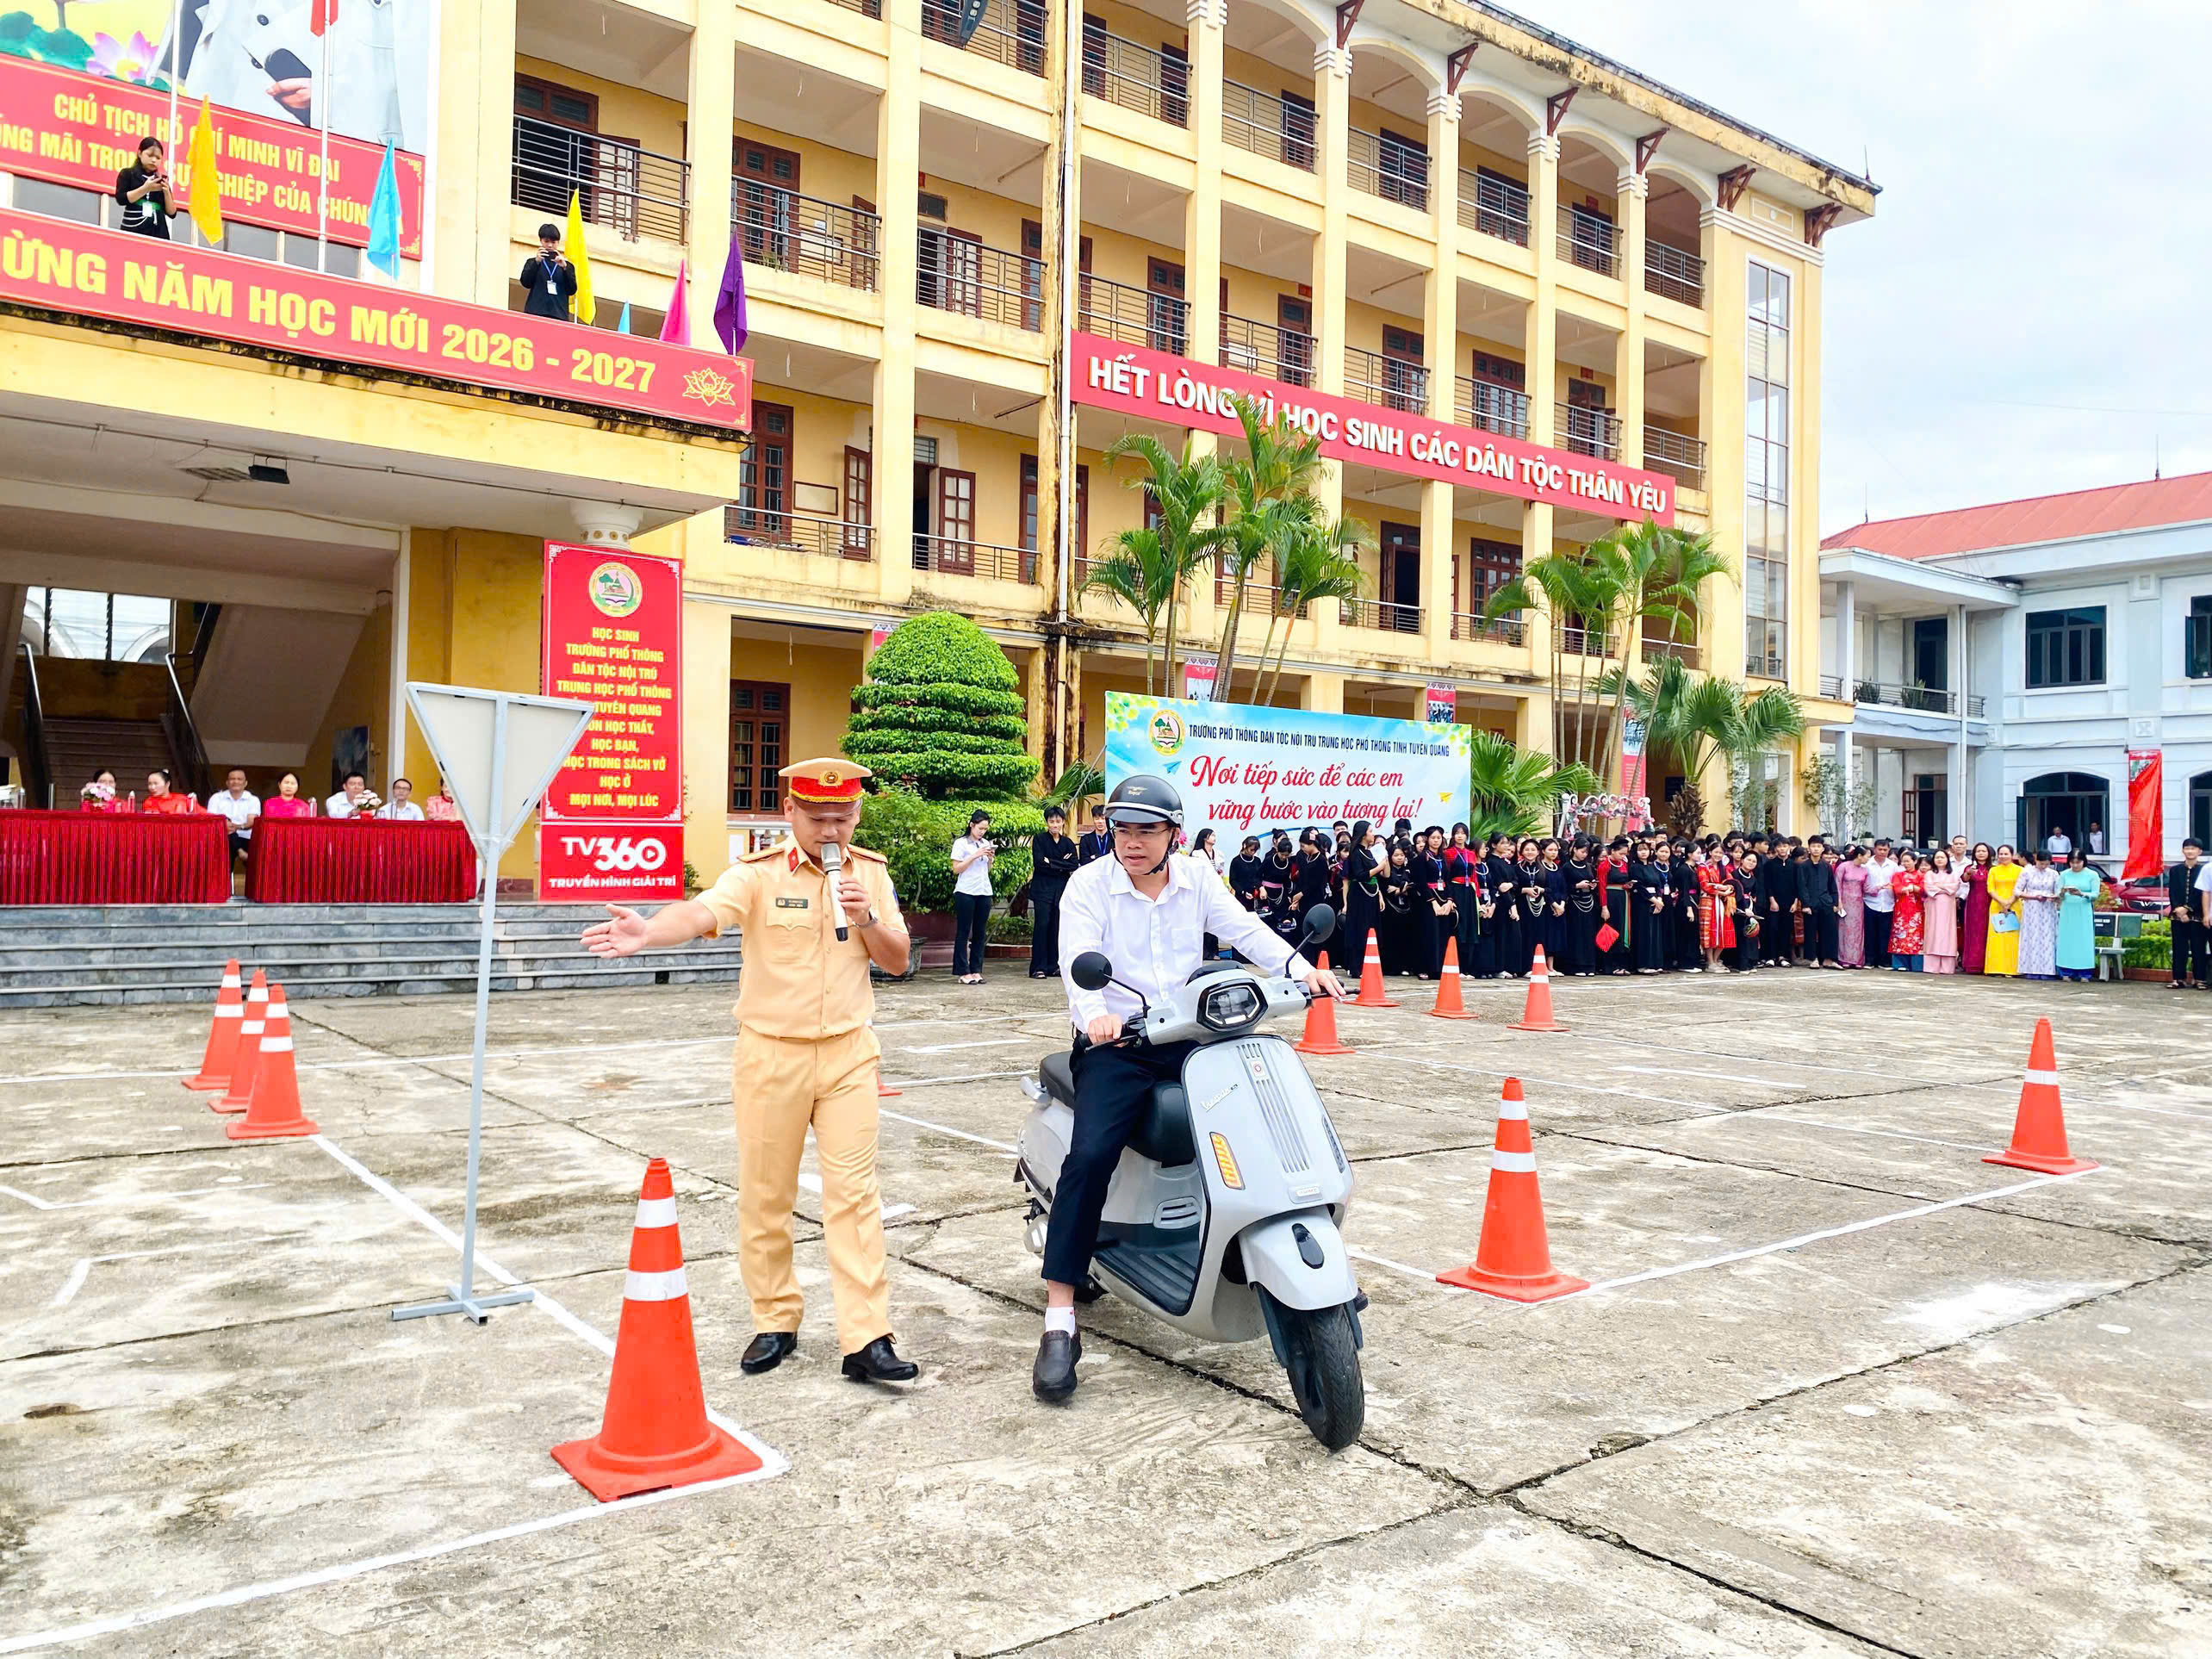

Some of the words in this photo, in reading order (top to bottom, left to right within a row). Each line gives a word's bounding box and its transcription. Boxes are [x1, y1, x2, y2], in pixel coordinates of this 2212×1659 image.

[54, 93, 97, 126] CHỦ
[103, 104, 150, 138] TỊCH
[228, 134, 280, 169] MINH
[286, 146, 303, 174] VĨ
[40, 132, 83, 164] MÃI
[273, 180, 312, 214] CỦA
[123, 260, 233, 318] NĂM
[249, 285, 336, 339] HỌC
[351, 306, 429, 353] MỚI
[442, 324, 534, 371] 2026
[571, 348, 656, 393] 2027
[1089, 353, 1151, 398] HẾT
[1158, 368, 1238, 419] LÒNG
[1345, 418, 1403, 457] SINH
[1408, 431, 1460, 468] CÁC
[1465, 444, 1514, 480] DÂN
[1519, 454, 1563, 494] TỘC
[1567, 469, 1624, 504] THÂN
[1627, 480, 1667, 513] YÊU
[593, 627, 612, 641] HỌC
[615, 629, 639, 642] SINH
[557, 680, 591, 693] TRUNG
[593, 682, 614, 697] HỌC
[629, 704, 662, 717] QUANG
[605, 720, 625, 735] HỌC
[592, 738, 612, 753] HỌC
[1318, 735, 1339, 749] TRUNG
[1430, 744, 1450, 756] QUANG
[587, 757, 621, 769] TRONG
[624, 756, 650, 770] SÁCH
[600, 775, 621, 790] HỌC
[1190, 755, 1240, 786] Nơi
[1243, 761, 1278, 793] tiếp
[1282, 766, 1315, 786] sức
[1319, 762, 1345, 786] để
[1346, 767, 1376, 787] các
[1380, 772, 1404, 787] em
[639, 793, 659, 807] LÚC
[1209, 798, 1256, 830] vững
[1260, 796, 1303, 820] bước
[1308, 801, 1338, 819] vào
[1342, 798, 1389, 829] tương
[1392, 796, 1423, 819] lai!
[560, 836, 667, 871] TV360
[601, 875, 630, 887] HÌNH
[656, 875, 676, 887] TRÍ
